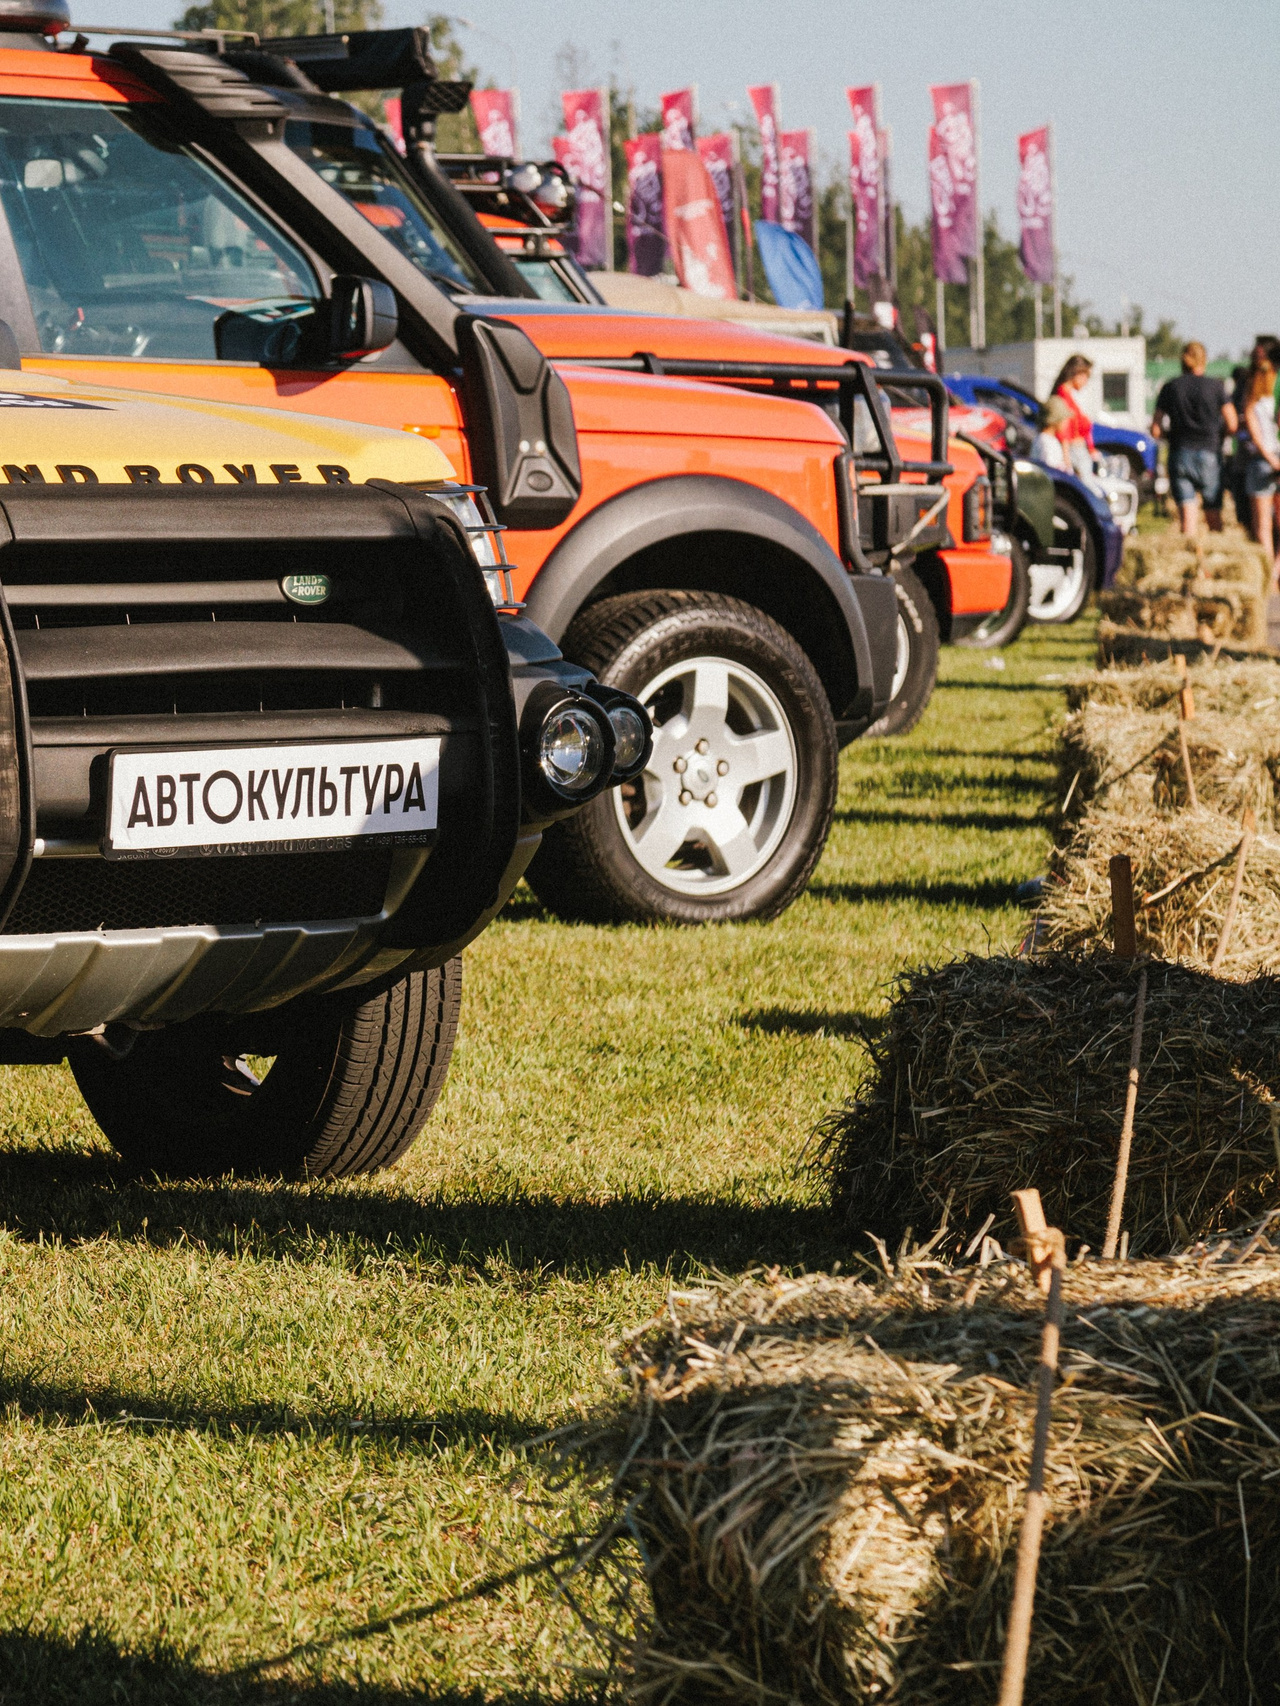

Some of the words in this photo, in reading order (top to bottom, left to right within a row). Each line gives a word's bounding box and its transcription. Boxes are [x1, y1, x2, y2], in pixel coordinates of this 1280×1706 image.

[123, 463, 353, 484] ROVER
[293, 576, 318, 586] LAND
[297, 585, 327, 596] ROVER
[126, 761, 427, 829] АВТОКУЛЬТУРА
[297, 837, 352, 851] MOTORS
